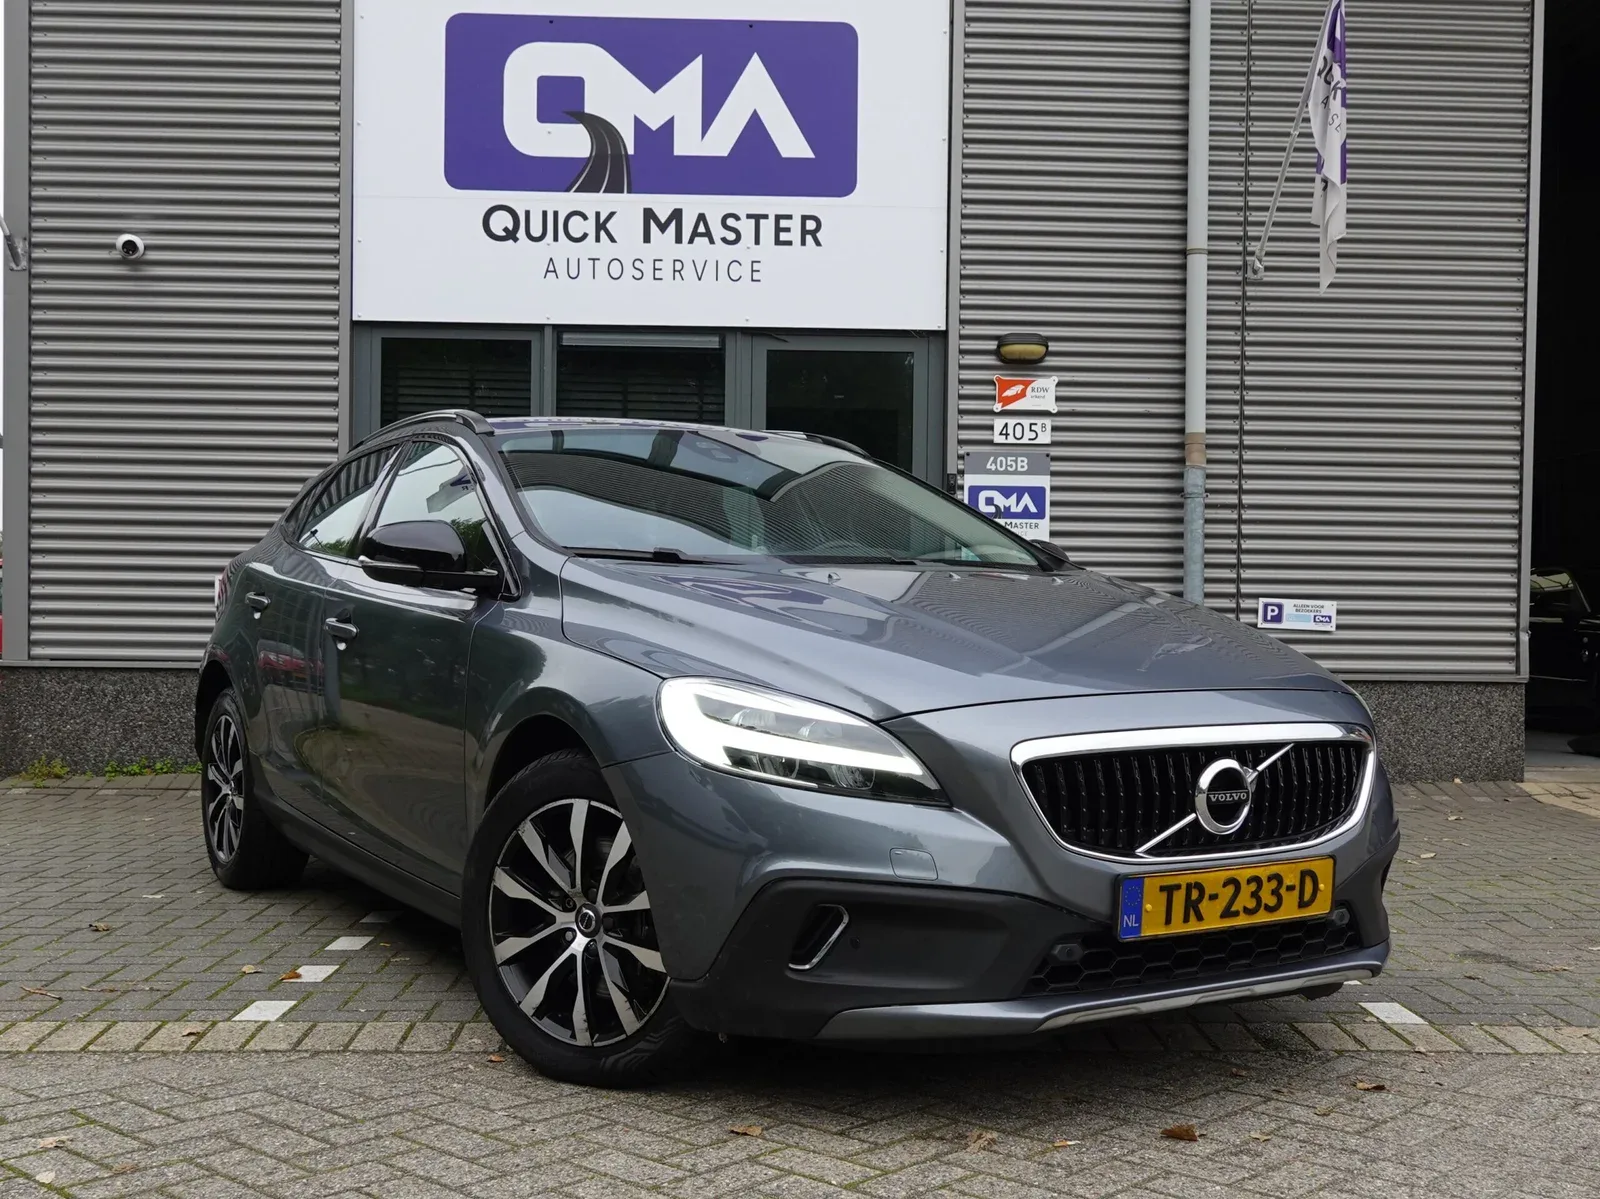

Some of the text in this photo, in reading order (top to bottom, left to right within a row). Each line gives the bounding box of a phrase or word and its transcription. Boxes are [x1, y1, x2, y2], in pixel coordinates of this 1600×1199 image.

[481, 204, 823, 247] QUICK MASTER
[543, 257, 762, 282] AUTOSERVICE
[986, 456, 1028, 471] 405B
[1004, 521, 1040, 530] MASTER
[1267, 605, 1279, 621] P
[1209, 792, 1247, 802] VOLVO
[1159, 869, 1319, 926] TR-233-D
[1123, 914, 1140, 928] NL
